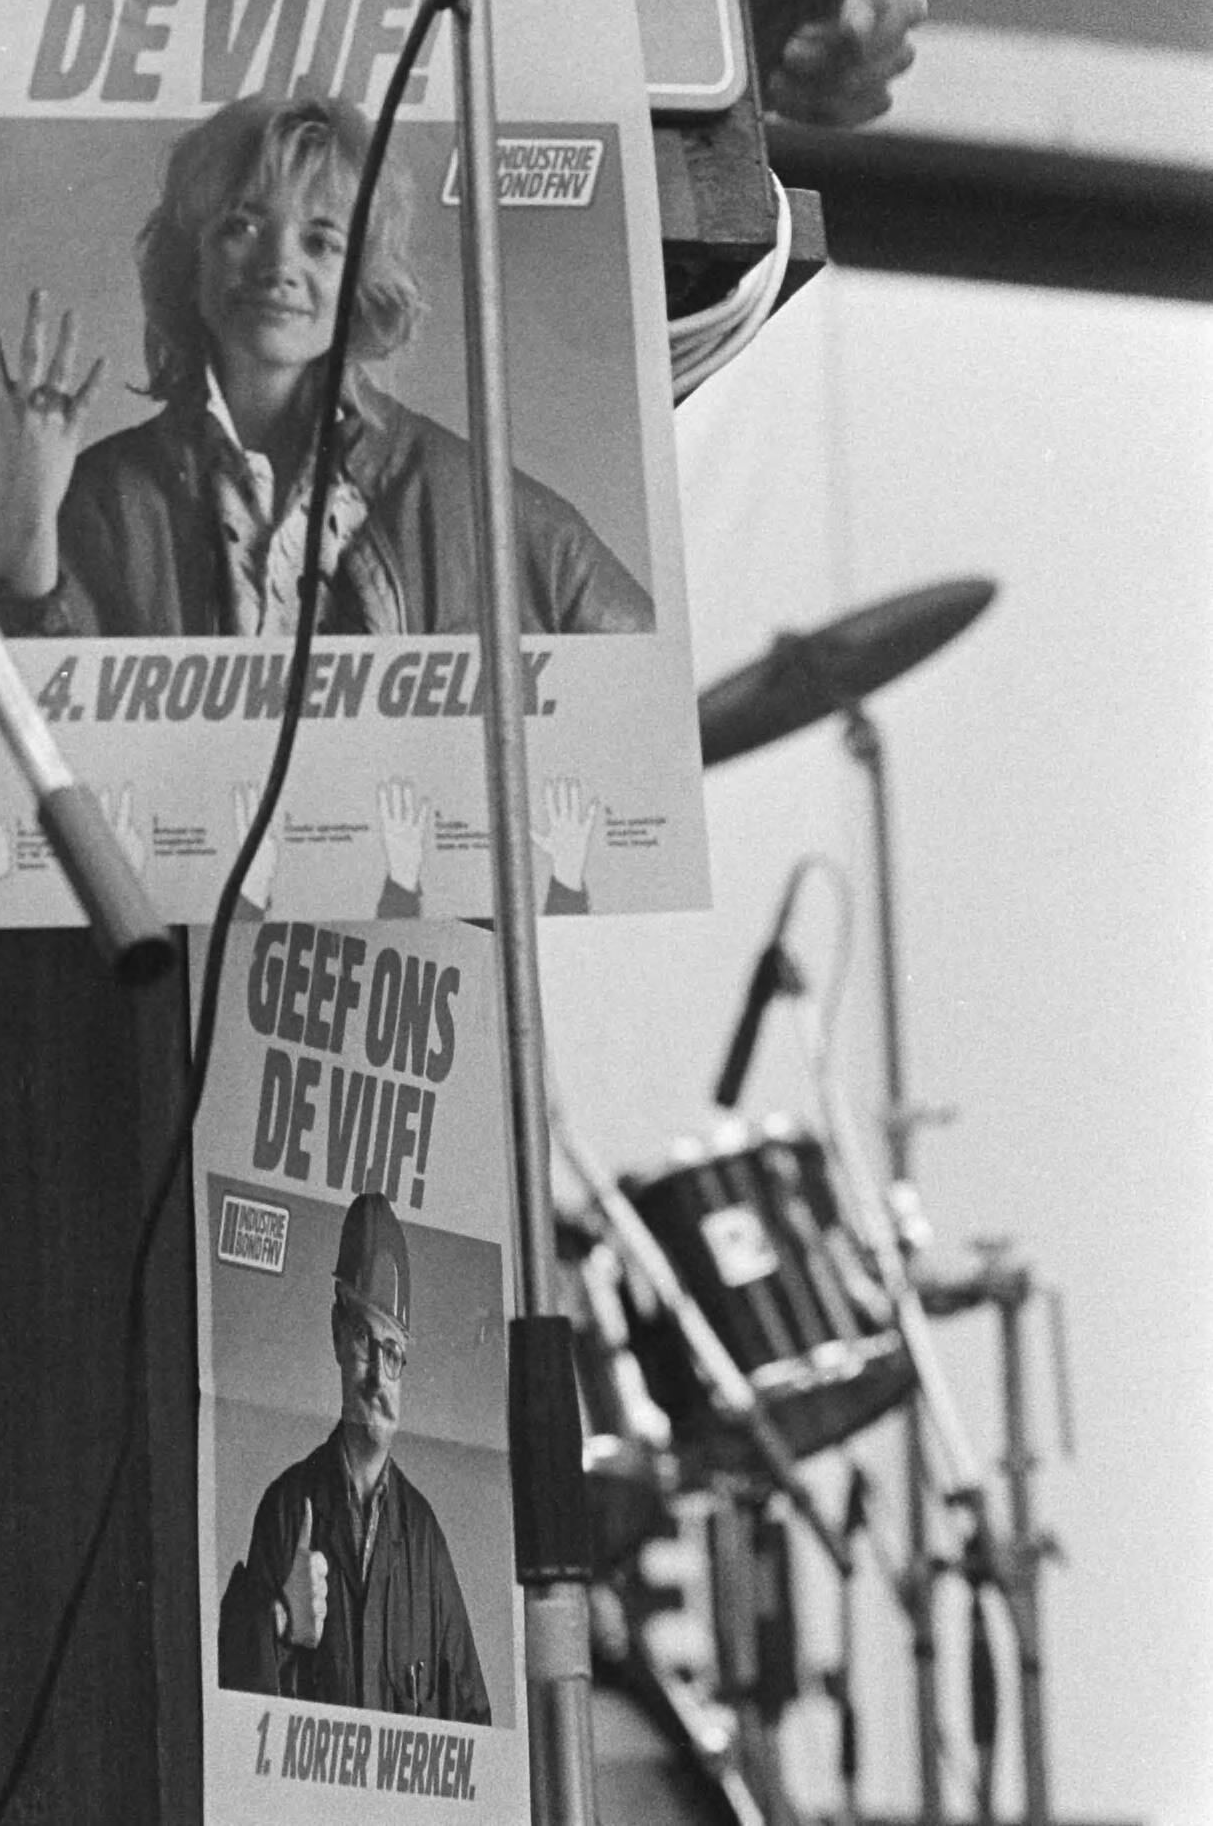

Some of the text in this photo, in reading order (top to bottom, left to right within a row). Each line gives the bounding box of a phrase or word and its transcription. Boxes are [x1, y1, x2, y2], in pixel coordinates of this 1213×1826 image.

[498, 145, 597, 170] NDUSTRIE
[498, 172, 589, 199] OND FNV
[36, 650, 557, 722] 4. VROUWEN GELK.
[247, 921, 461, 1084] GEEF ONS
[252, 1046, 437, 1210] DE VIJF!
[254, 1710, 477, 1802] 1. KORTER WERKEN.
